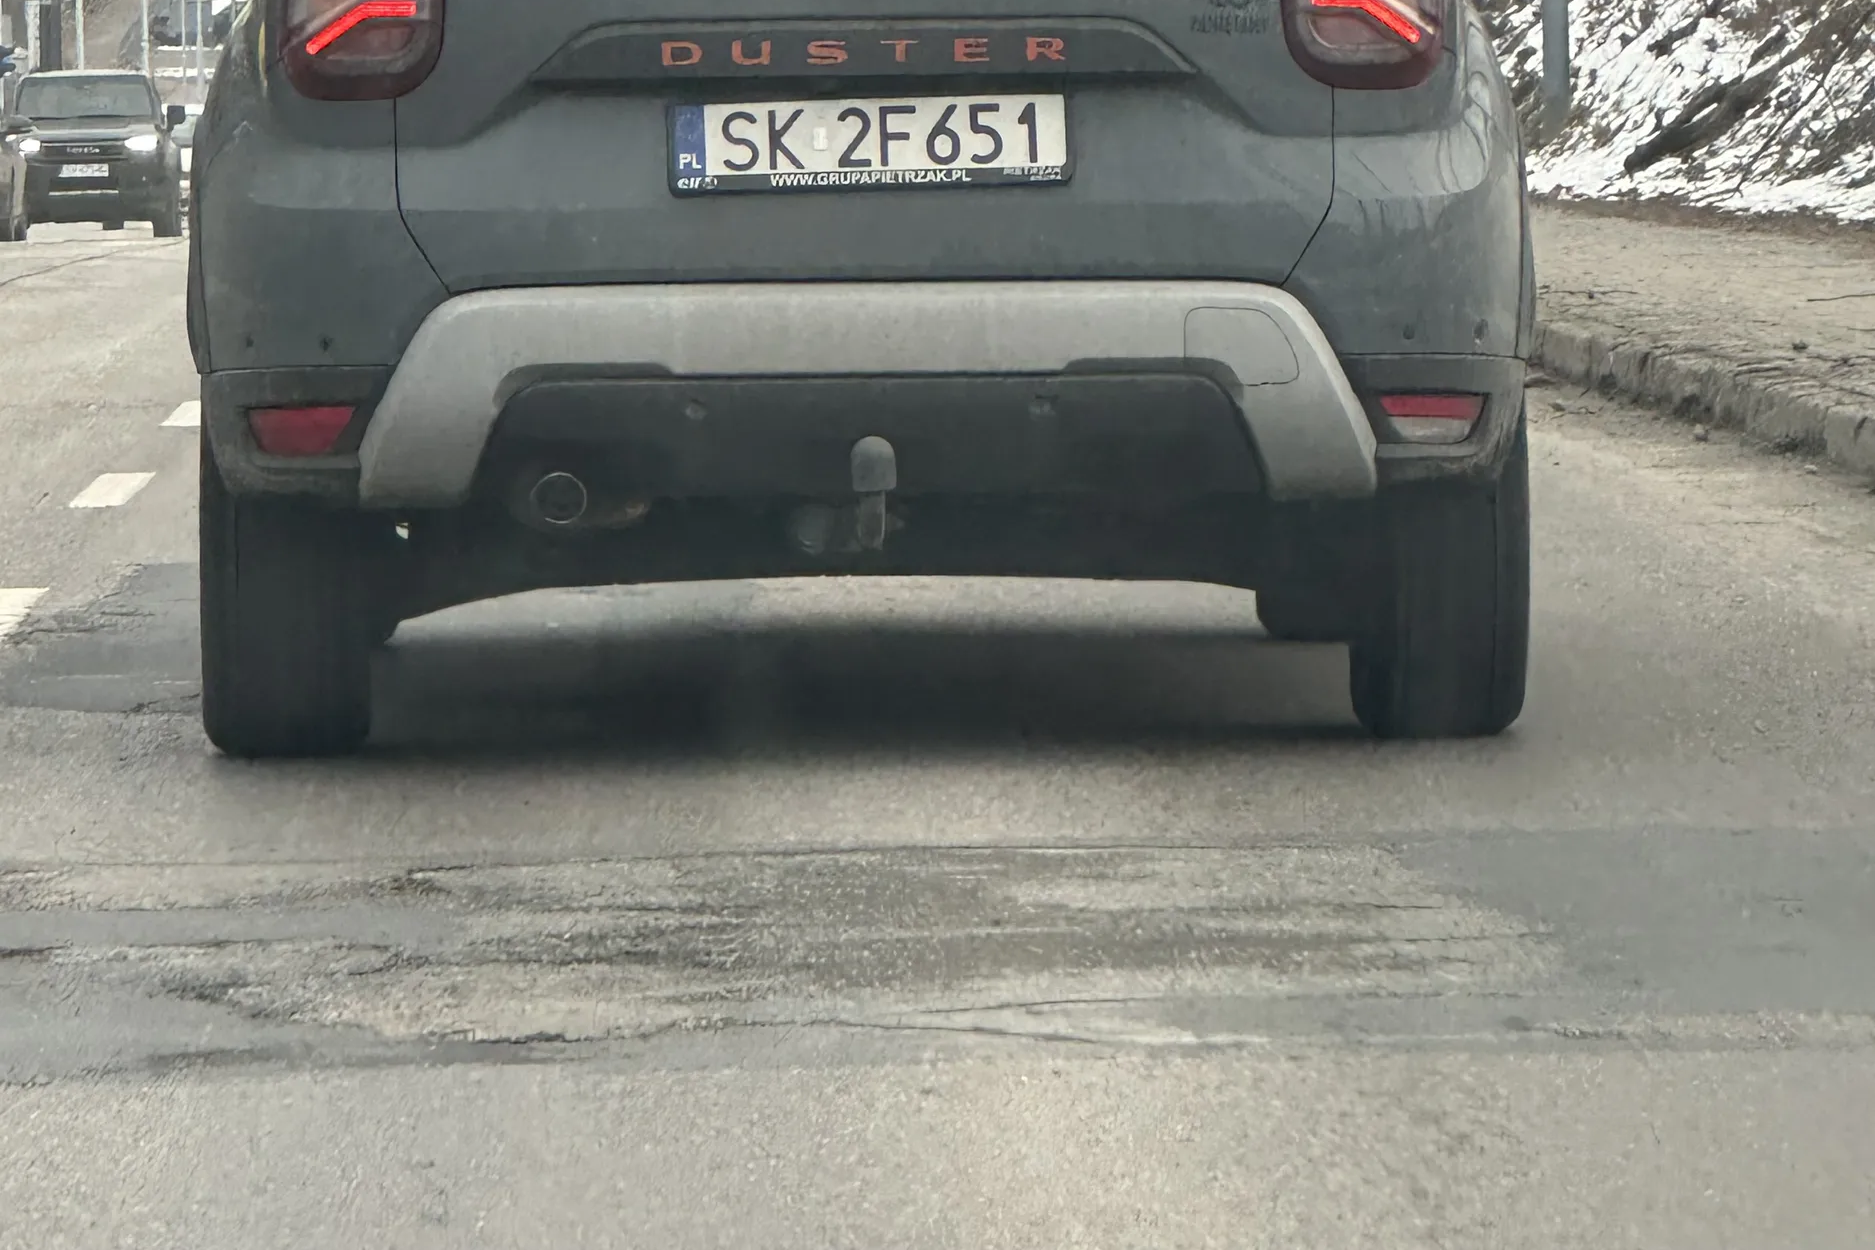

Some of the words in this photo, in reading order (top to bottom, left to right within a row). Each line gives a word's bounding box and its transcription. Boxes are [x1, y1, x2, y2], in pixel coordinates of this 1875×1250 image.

[660, 36, 1067, 67] DUSTER
[721, 108, 806, 172] SK
[837, 102, 1039, 169] 2F651
[678, 153, 702, 170] PL
